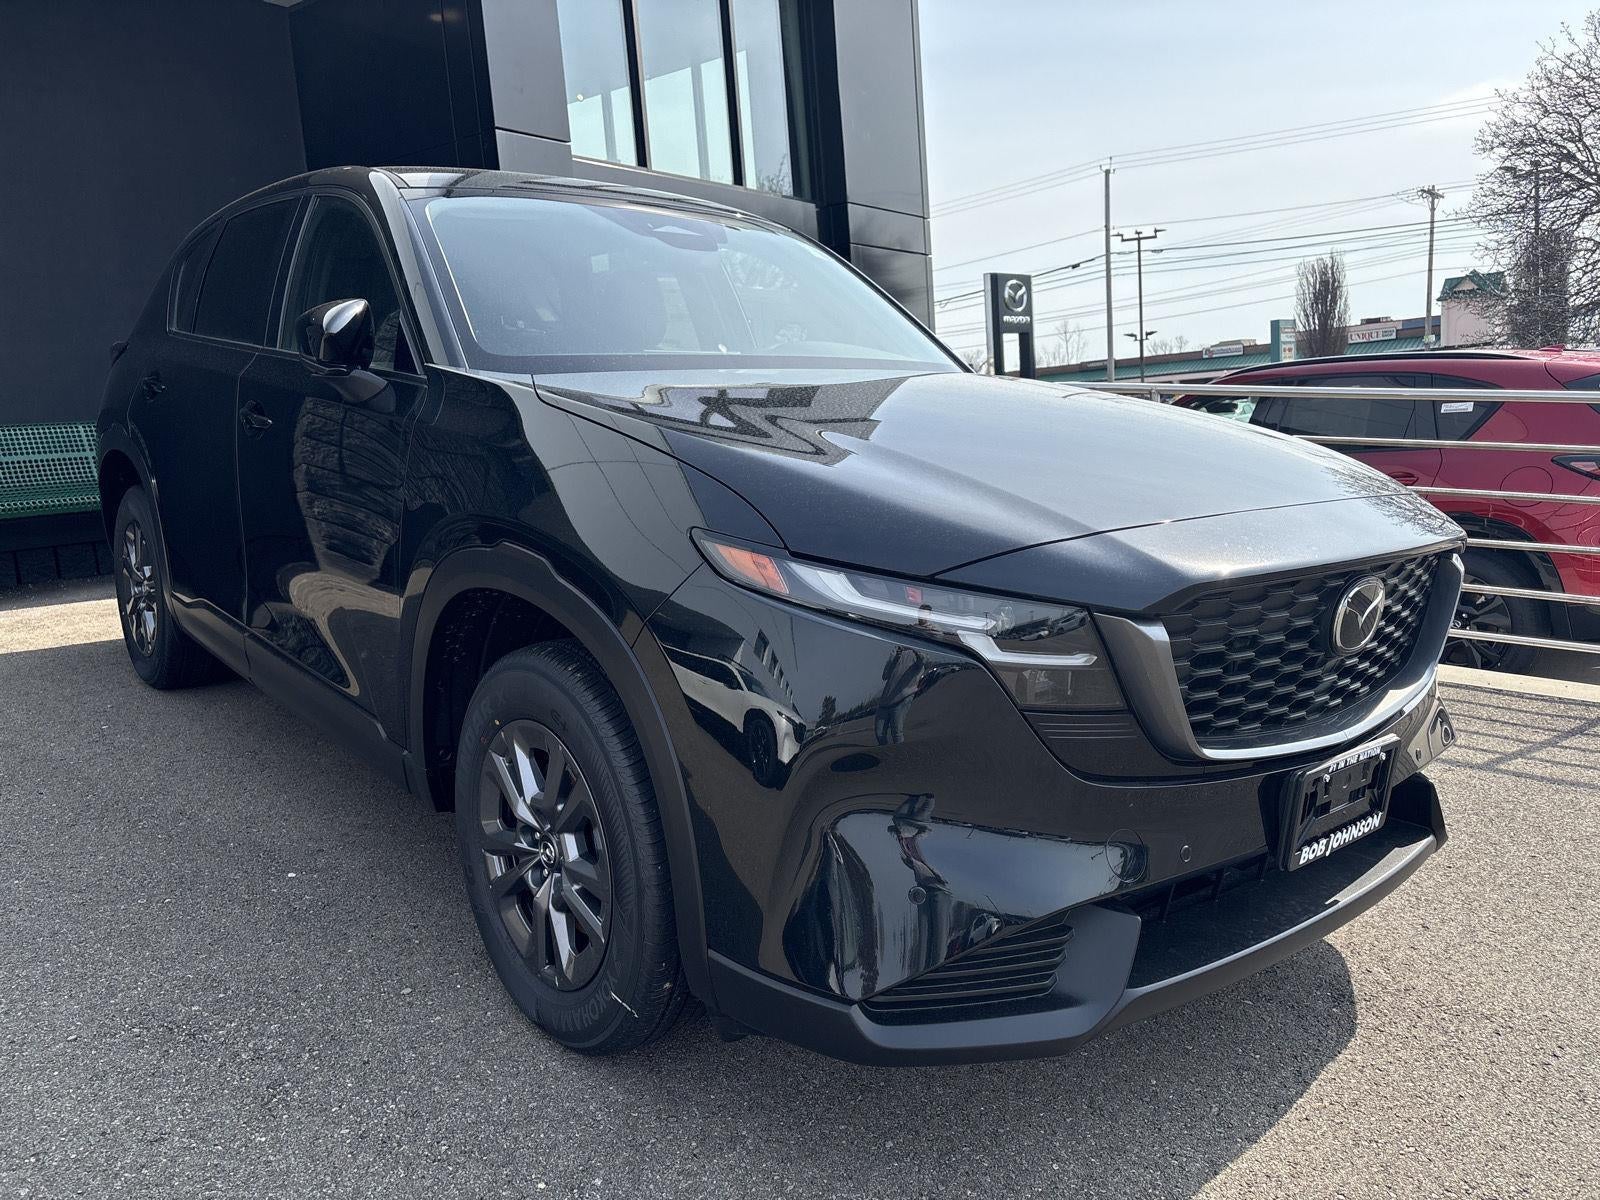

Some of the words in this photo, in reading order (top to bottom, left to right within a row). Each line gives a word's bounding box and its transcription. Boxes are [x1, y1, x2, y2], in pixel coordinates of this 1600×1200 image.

[1338, 760, 1346, 770] IN
[1346, 754, 1359, 766] THE
[1359, 746, 1381, 761] NATION
[1297, 838, 1329, 865] BOB
[1325, 812, 1383, 857] JOHNSON
